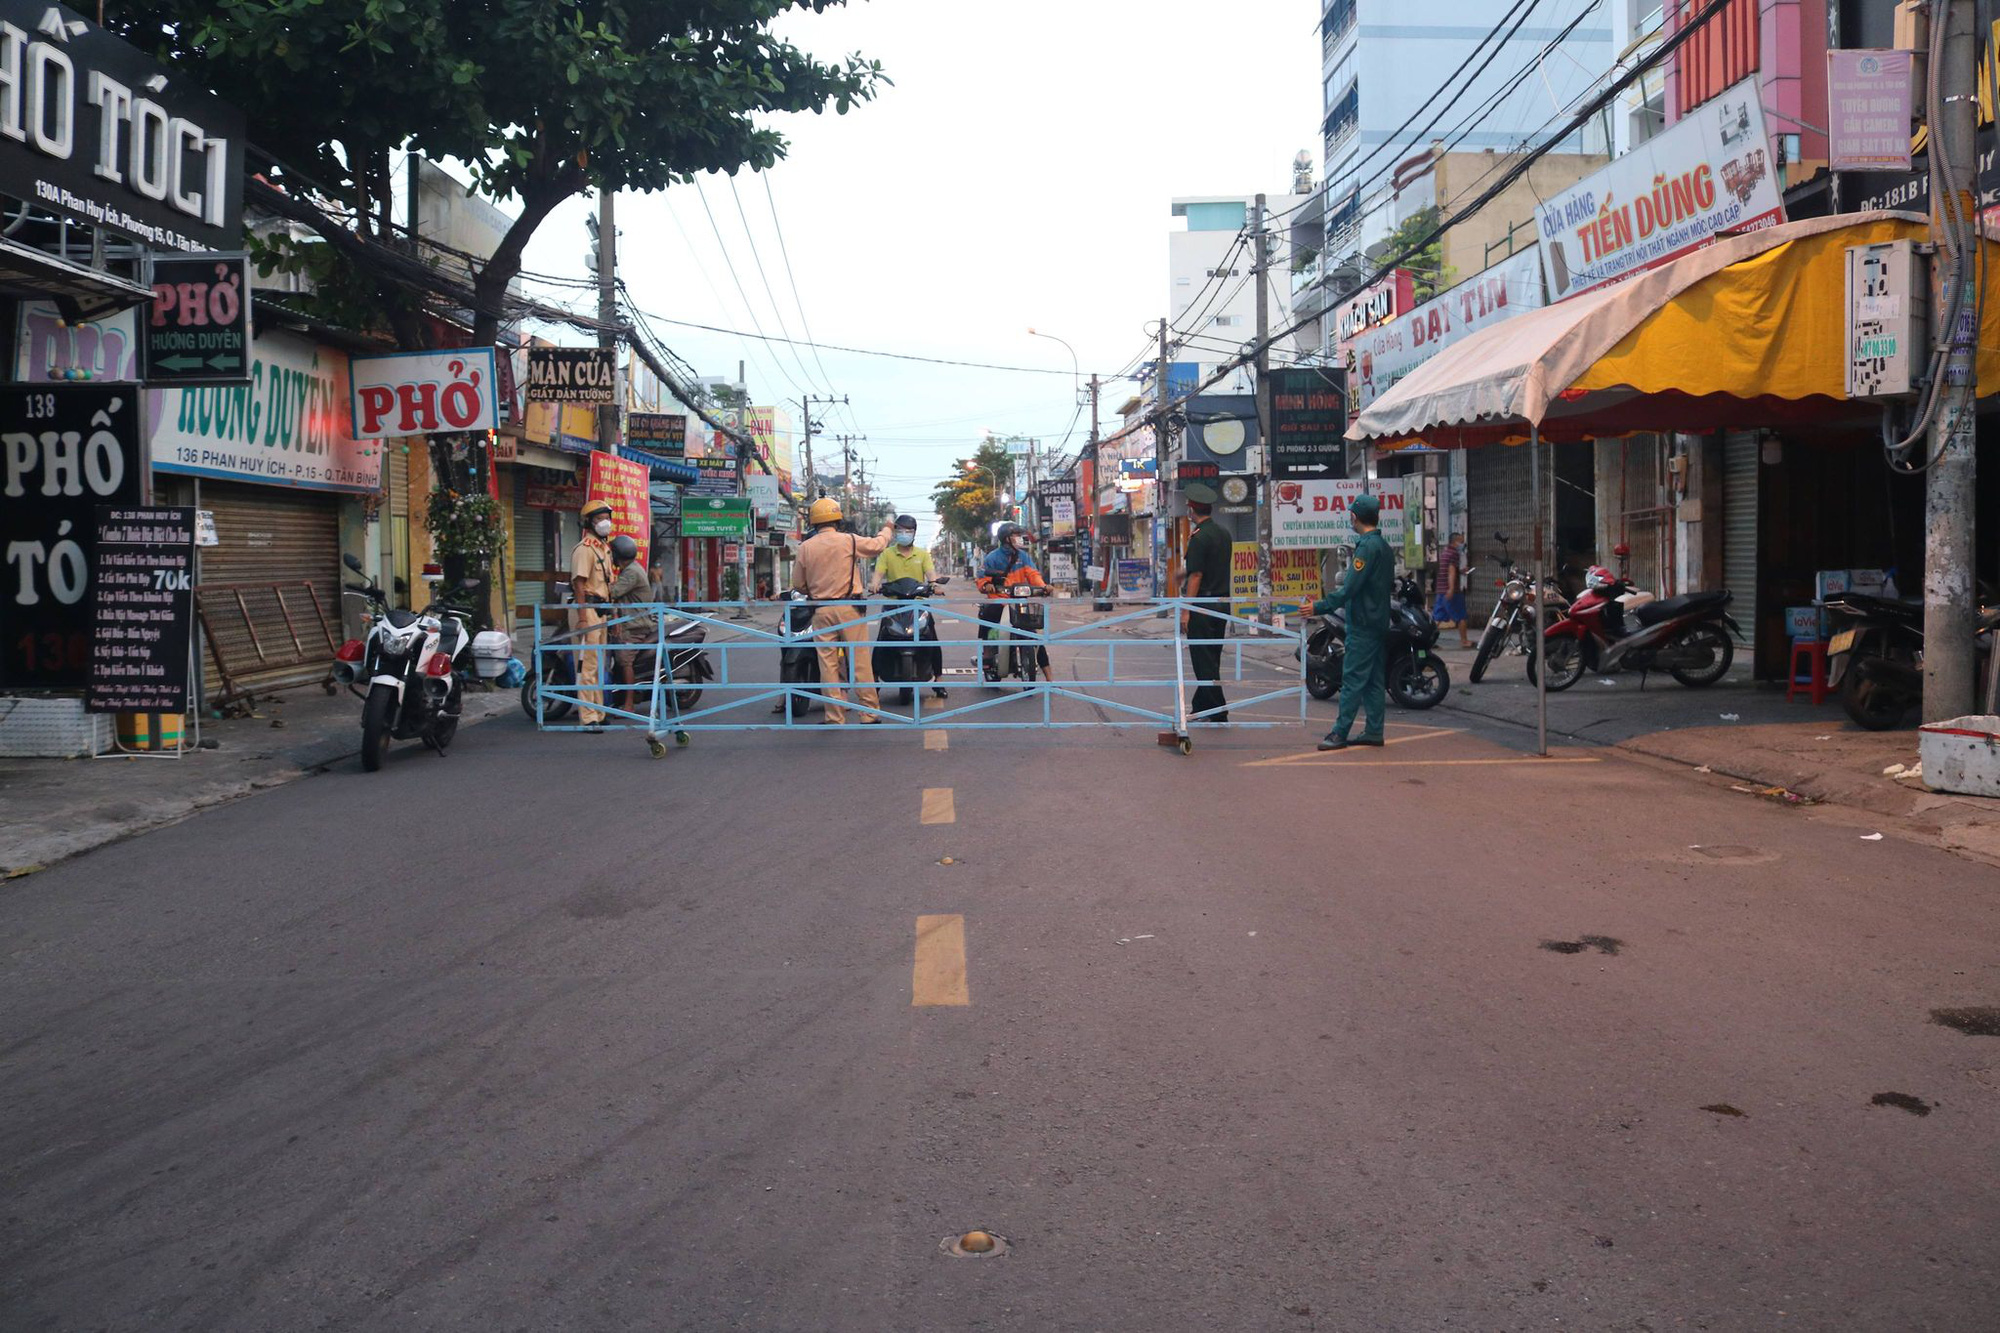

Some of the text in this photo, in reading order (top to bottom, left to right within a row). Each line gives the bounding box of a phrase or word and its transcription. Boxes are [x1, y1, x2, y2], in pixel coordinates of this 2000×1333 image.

[1863, 118, 1898, 133] CAMERA
[35, 179, 60, 204] 130A
[60, 190, 85, 214] Phan
[86, 198, 105, 223] Huy
[1542, 191, 1596, 239] CỬA HÀNG
[1576, 163, 1716, 264] TIẾN DŨNG
[1666, 228, 1690, 251] NGÀNH
[1689, 219, 1708, 243] MỘC
[1707, 213, 1724, 231] CAO
[1723, 199, 1740, 225] CẤP
[151, 262, 240, 326] PHỞ
[1338, 288, 1389, 342] KHÁCH SẠN
[199, 331, 241, 350] DUYÊN
[530, 352, 612, 387] MÀN CỬA
[25, 393, 56, 419] 138
[264, 351, 335, 456] DUYÊN
[357, 360, 481, 434] PHỞ
[531, 384, 612, 400] GIẤY DÁN TƯỜNG
[1, 396, 125, 498] PHỐ
[176, 446, 198, 464] 136
[202, 450, 236, 469] PHAN
[240, 455, 264, 473] HUY
[267, 458, 286, 476] ÍCH
[295, 466, 317, 479] P.15
[1336, 481, 1382, 490] Cửa Hng
[153, 569, 191, 591] 70k
